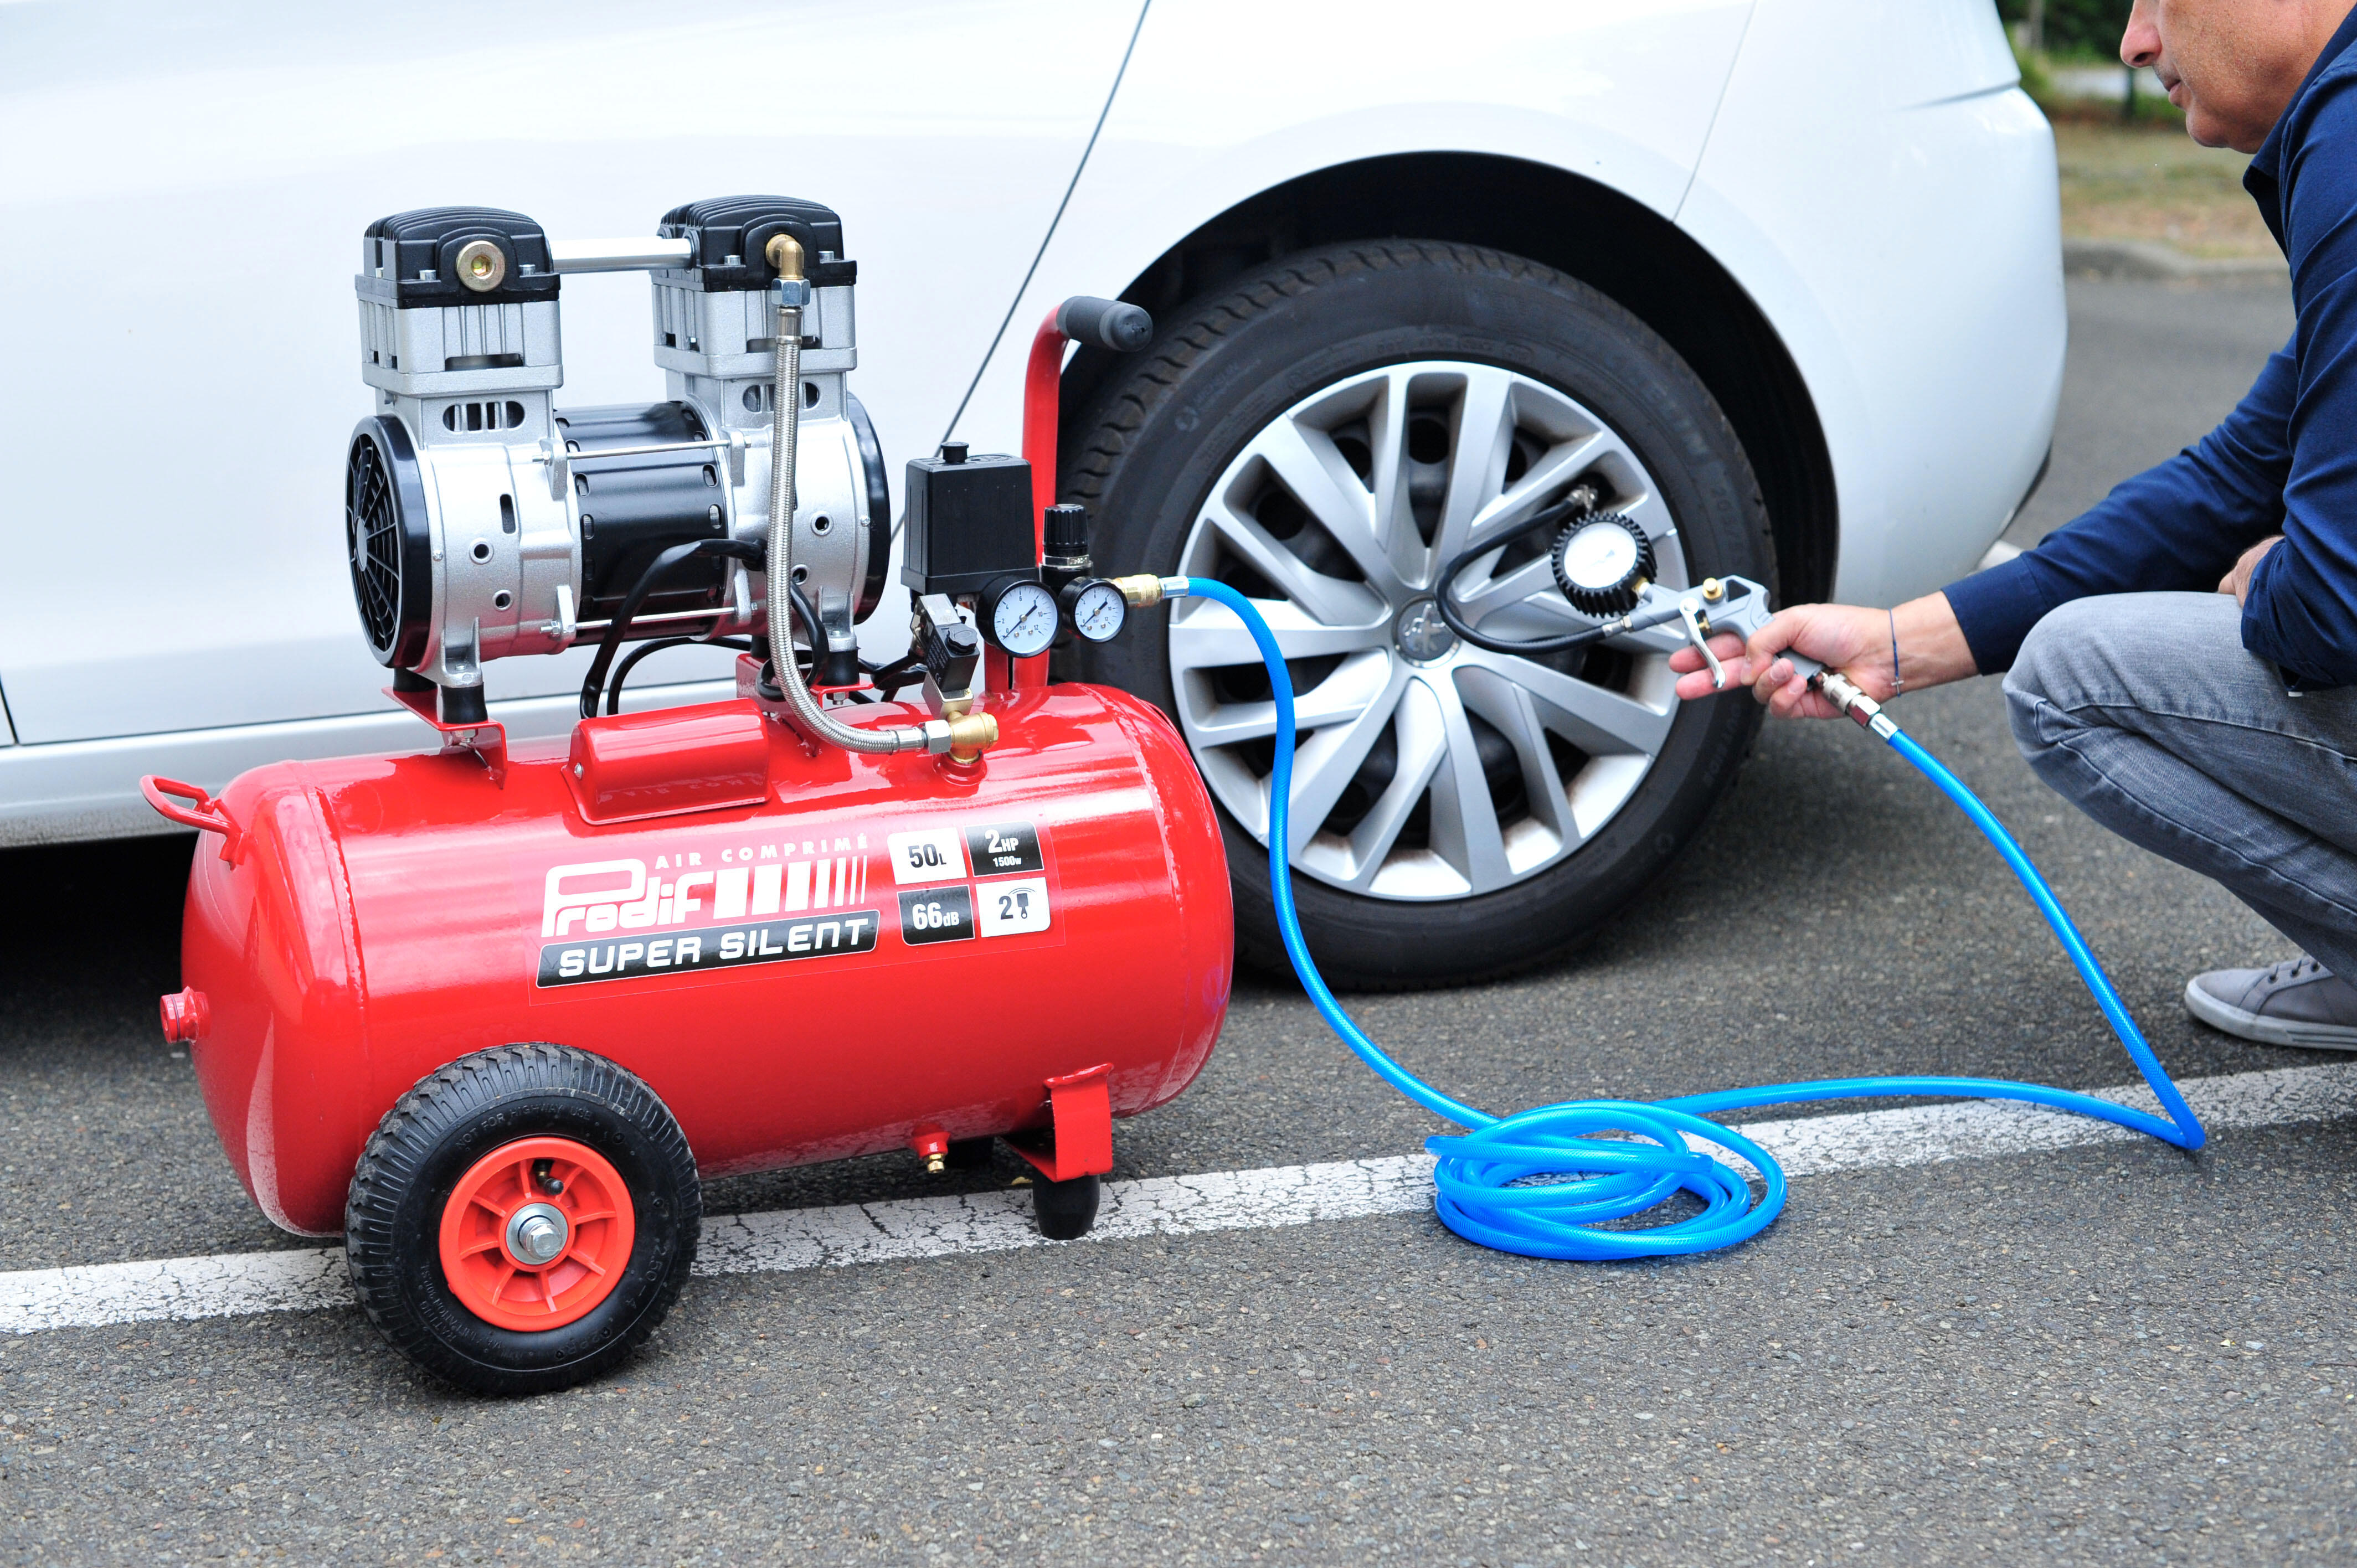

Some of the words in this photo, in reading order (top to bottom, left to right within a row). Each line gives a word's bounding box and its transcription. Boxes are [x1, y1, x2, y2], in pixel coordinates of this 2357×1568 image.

[655, 852, 702, 869] AIR
[722, 833, 868, 863] COMPRIMÉ
[908, 844, 946, 868] 50L
[985, 829, 1019, 853] 2HP
[541, 858, 714, 937] Prodif
[999, 895, 1013, 920] 2
[912, 902, 960, 930] 66dB
[559, 936, 702, 977] SUPER
[719, 918, 868, 960] SILENT
[456, 1127, 477, 1150] NOT
[481, 1112, 506, 1131] FOR
[510, 1103, 563, 1118] HIGHWAY
[570, 1106, 593, 1121] USE
